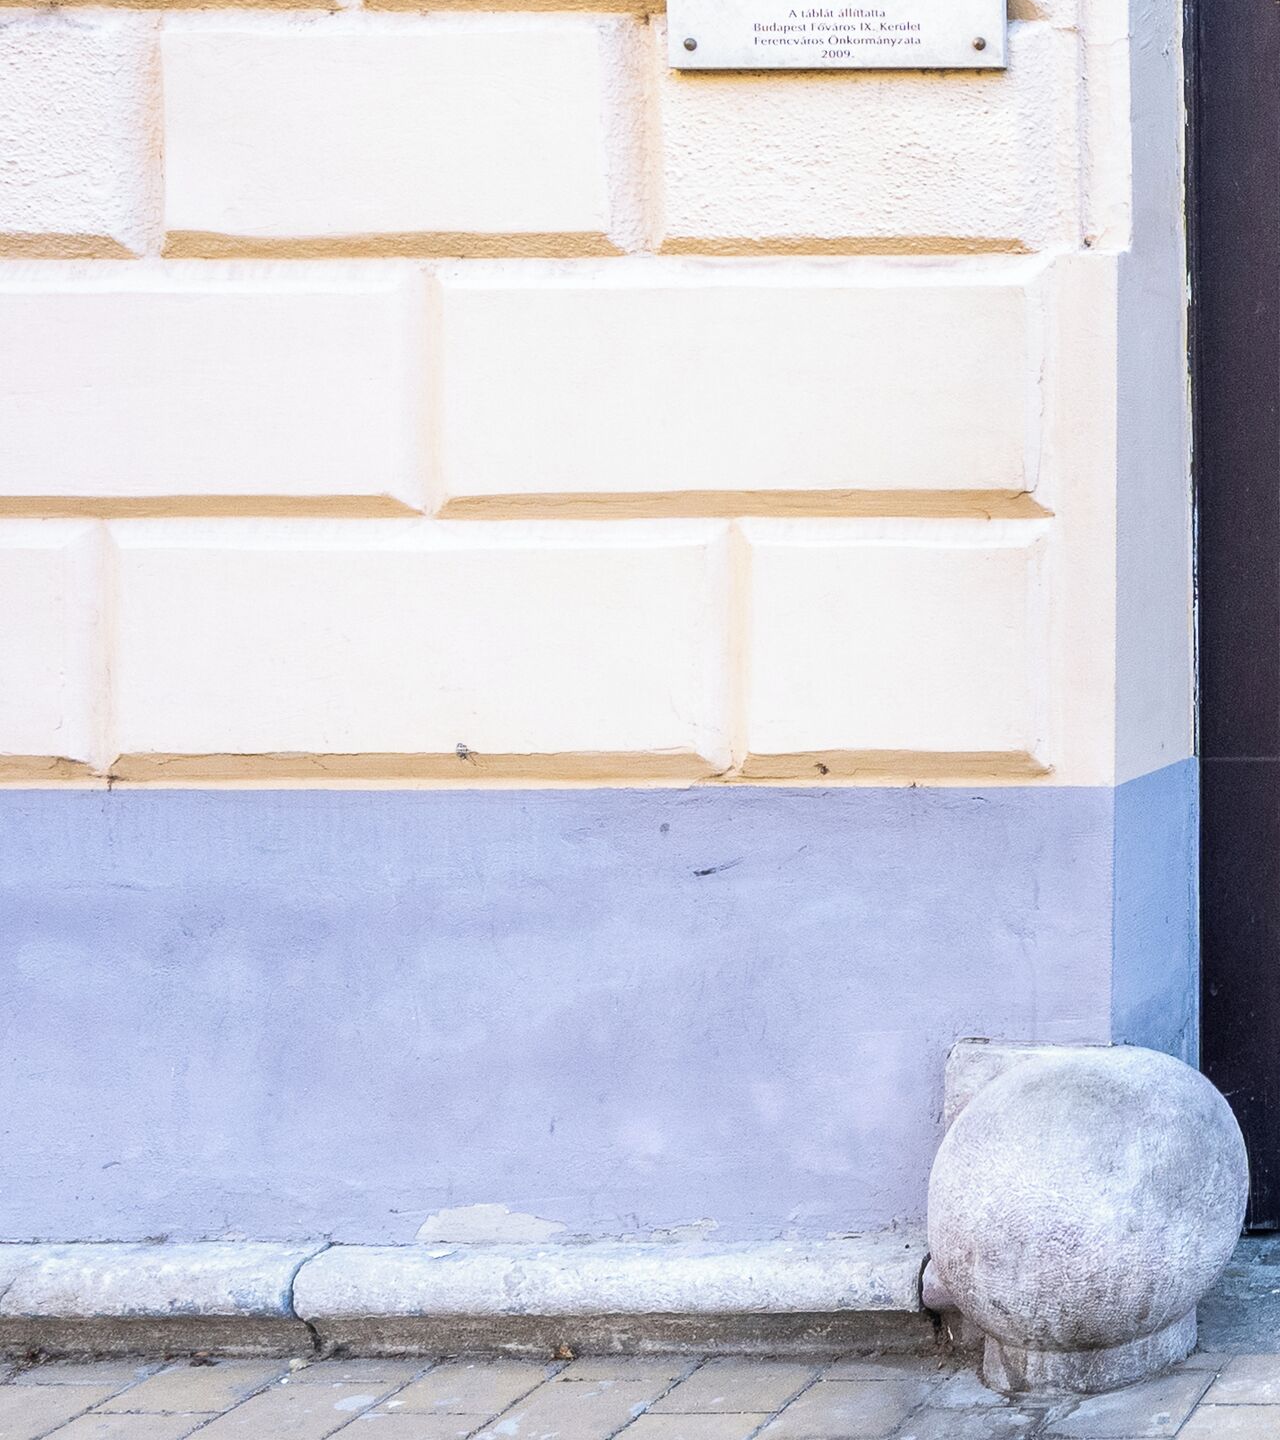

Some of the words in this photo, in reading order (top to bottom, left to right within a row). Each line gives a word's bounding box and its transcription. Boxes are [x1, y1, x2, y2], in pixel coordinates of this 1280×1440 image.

[788, 9, 798, 18] A
[801, 8, 834, 18] táblát
[753, 21, 806, 34] Budapest
[879, 20, 921, 32] Kerület
[754, 36, 825, 46] Ferencváros
[827, 34, 921, 48] Önkormányzata
[821, 49, 855, 59] 2009.
